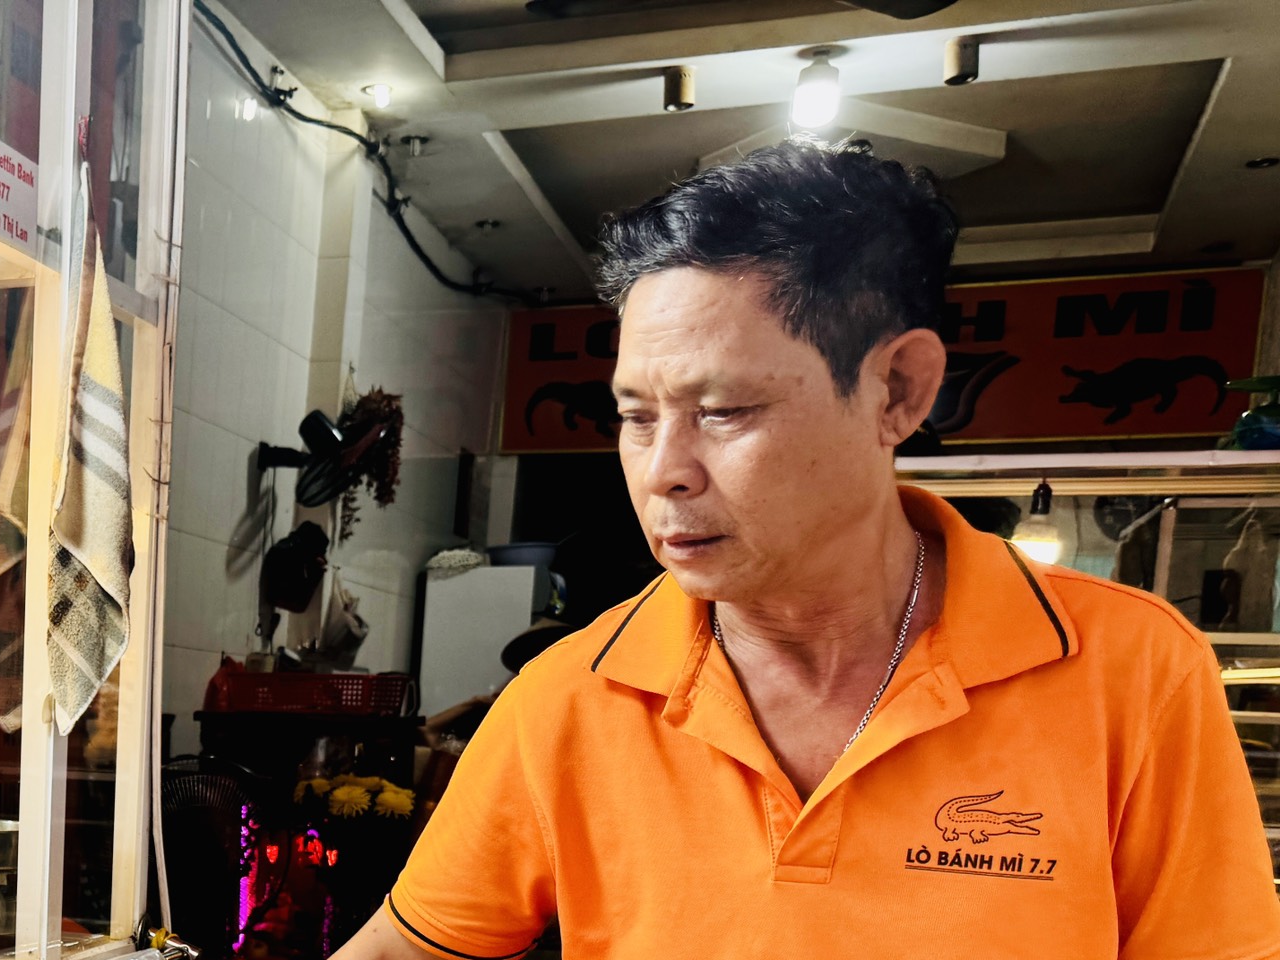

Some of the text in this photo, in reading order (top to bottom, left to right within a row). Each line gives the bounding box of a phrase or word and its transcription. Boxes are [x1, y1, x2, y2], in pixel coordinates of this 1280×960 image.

[17, 163, 35, 188] Bank
[2, 213, 14, 239] Thị
[15, 221, 28, 243] Lan
[1053, 279, 1217, 338] MÌ
[905, 844, 1058, 875] LÒ BÁNH MÌ 7.7
